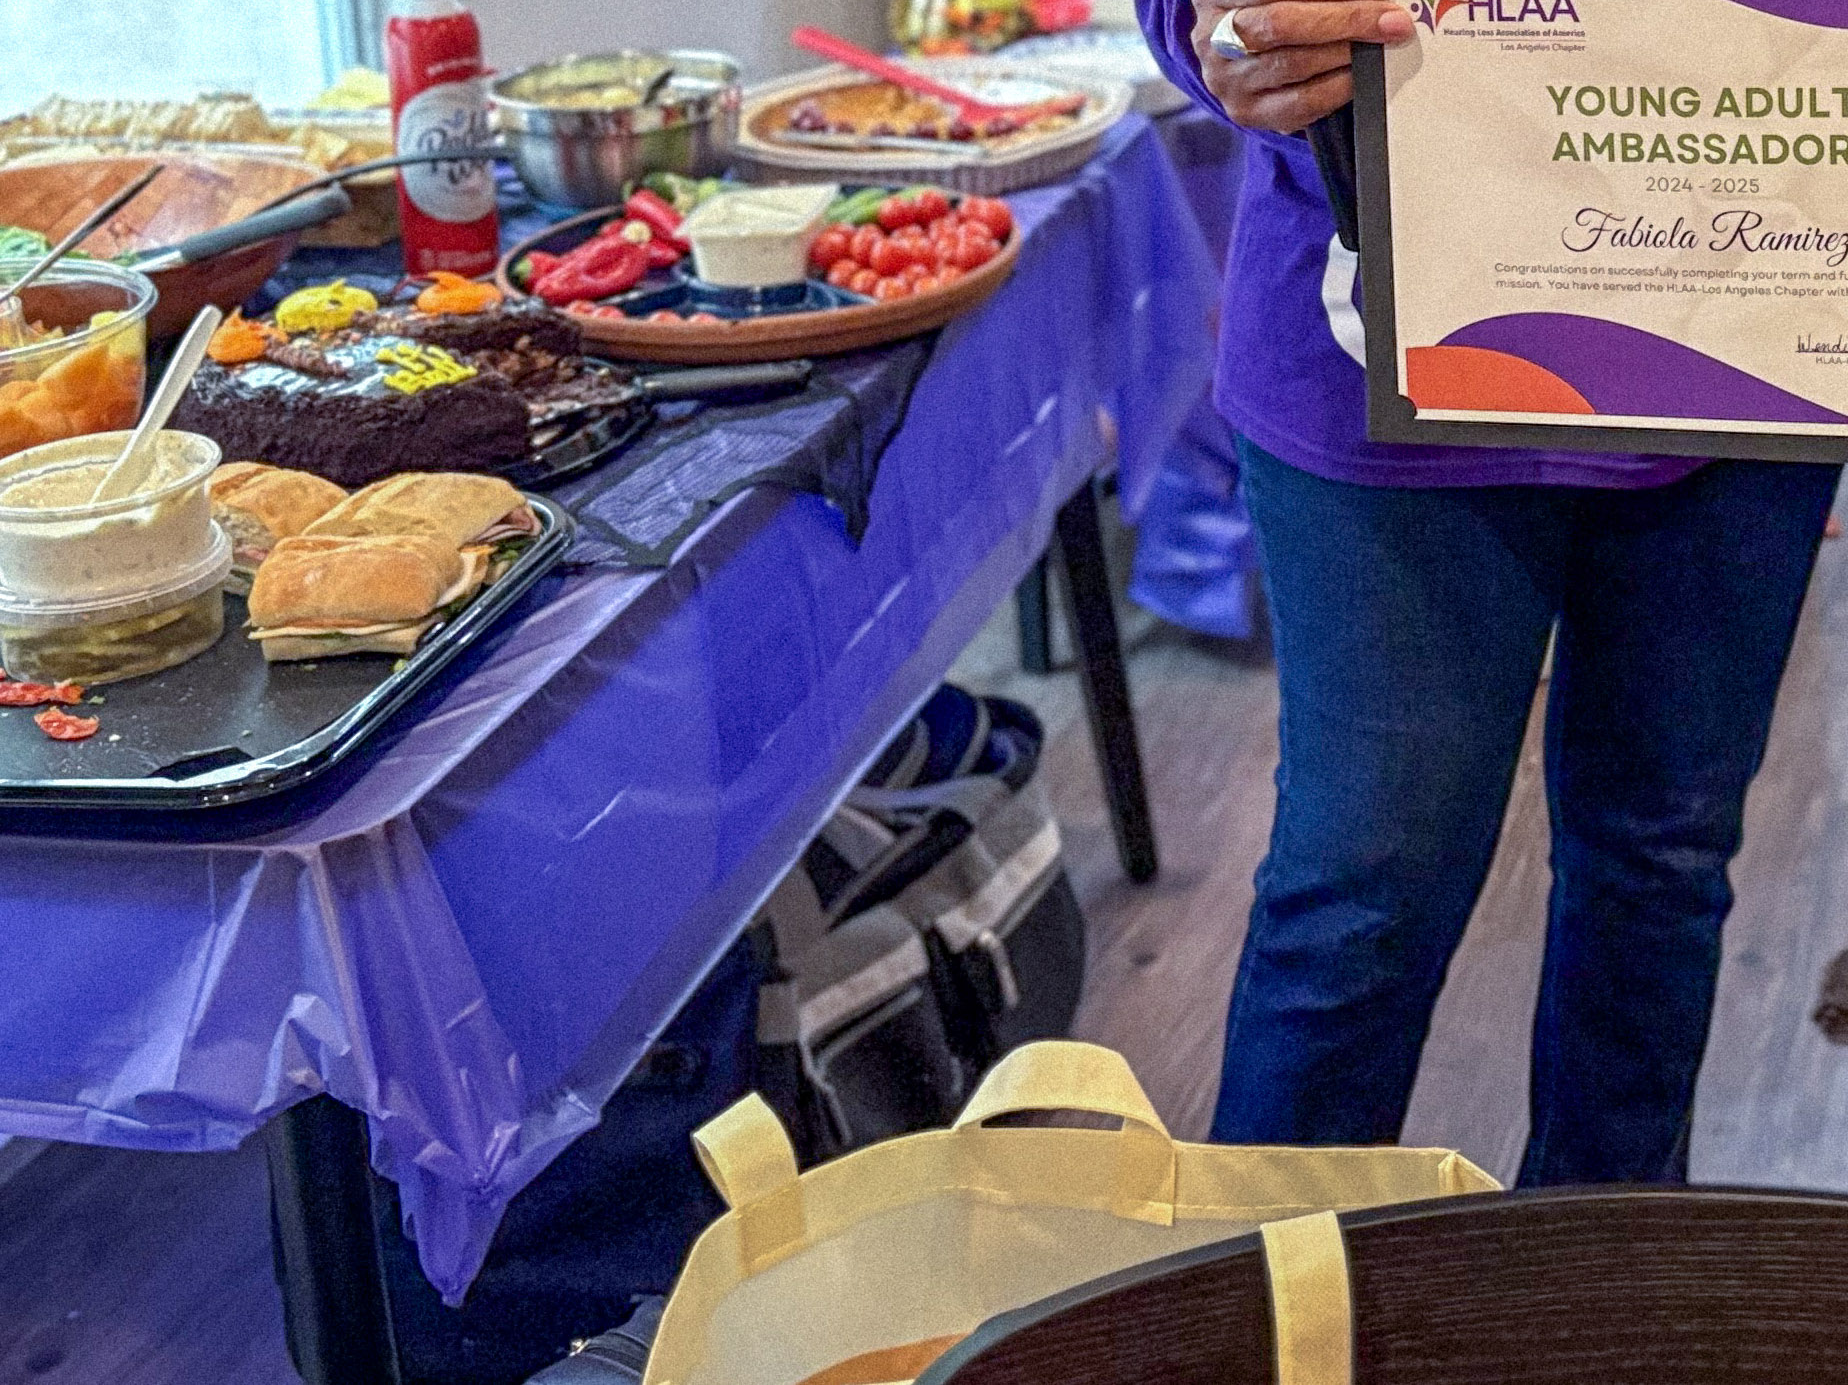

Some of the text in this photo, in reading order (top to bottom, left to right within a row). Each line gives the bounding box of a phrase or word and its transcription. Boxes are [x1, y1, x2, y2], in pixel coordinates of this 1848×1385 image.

[1443, 28, 1586, 38] Hearing Loss Association of America
[1500, 43, 1586, 53] Los Angeles Chapter
[1546, 85, 1701, 117] YOUNG
[1645, 176, 1693, 192] 2024
[1712, 178, 1760, 194] 2025
[1561, 207, 1699, 253] Fabiola
[1494, 262, 1588, 275] Congratulations
[1590, 267, 1605, 275] on
[1607, 266, 1679, 279] successfully
[1681, 268, 1749, 281] completing
[1751, 271, 1778, 282] your
[1781, 271, 1810, 280] term
[1813, 271, 1836, 281] and
[1495, 279, 1542, 289] mission.
[1548, 279, 1570, 290] You
[1572, 281, 1600, 291] have
[1602, 282, 1642, 292] served
[1644, 282, 1664, 292] the
[1724, 285, 1772, 297] Angeles
[1774, 286, 1824, 298] Chapter
